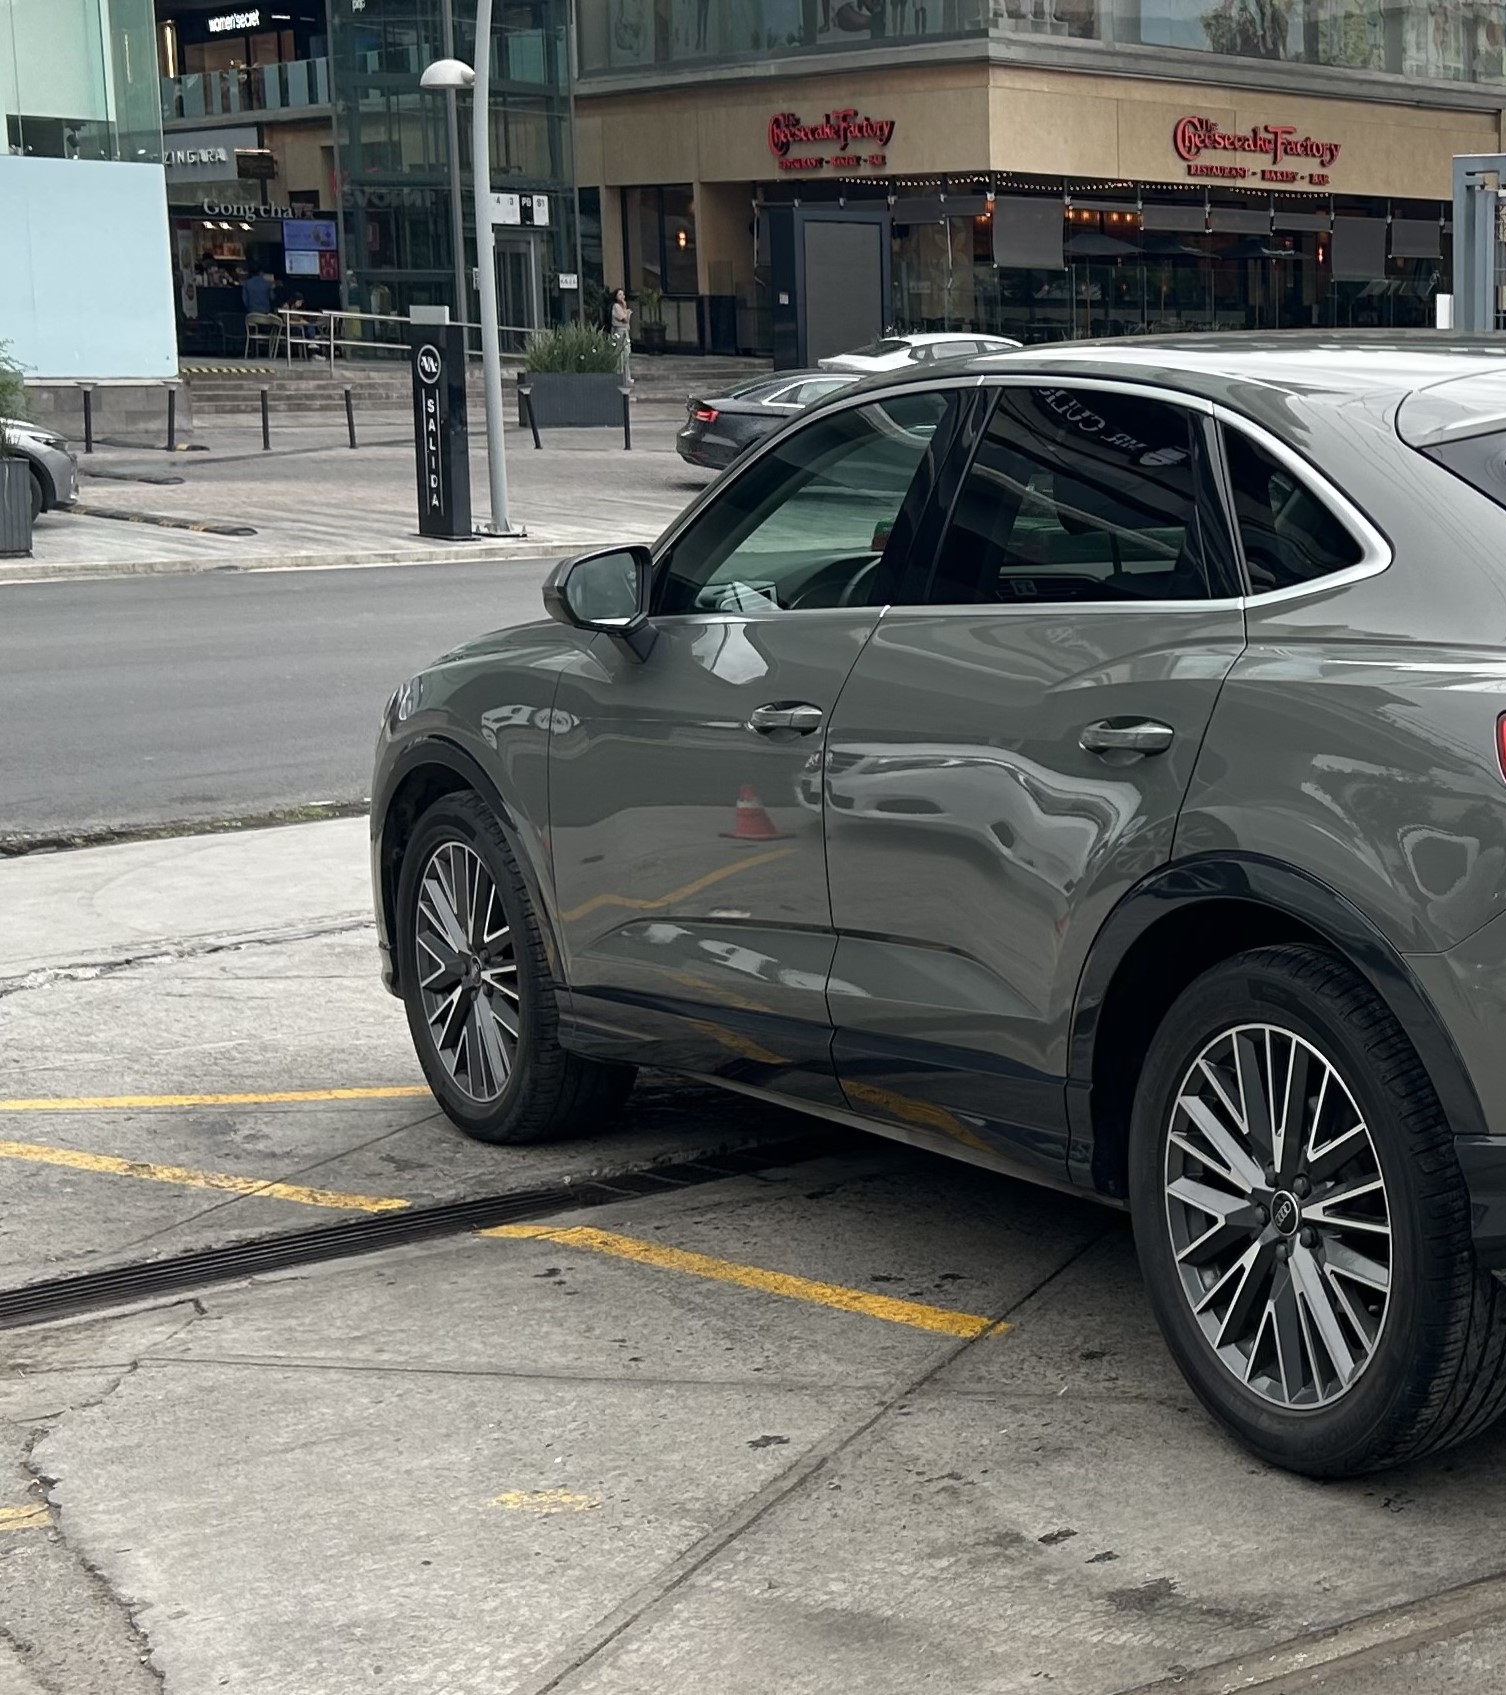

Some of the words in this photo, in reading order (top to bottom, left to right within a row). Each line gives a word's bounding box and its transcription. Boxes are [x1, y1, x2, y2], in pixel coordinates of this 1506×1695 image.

[208, 9, 260, 32] women'secret
[768, 113, 840, 157] Cheesecake
[831, 108, 895, 152] Factory
[1174, 116, 1274, 161] Cheesecake
[1264, 125, 1341, 167] Factory
[164, 148, 228, 164] ZINGARA
[1187, 164, 1250, 178] RESTAURANT
[1261, 169, 1299, 183] BAKERY
[1308, 173, 1330, 186] BAR
[203, 198, 256, 222] Gong
[260, 201, 294, 219] cha
[427, 399, 439, 507] SALIDA
